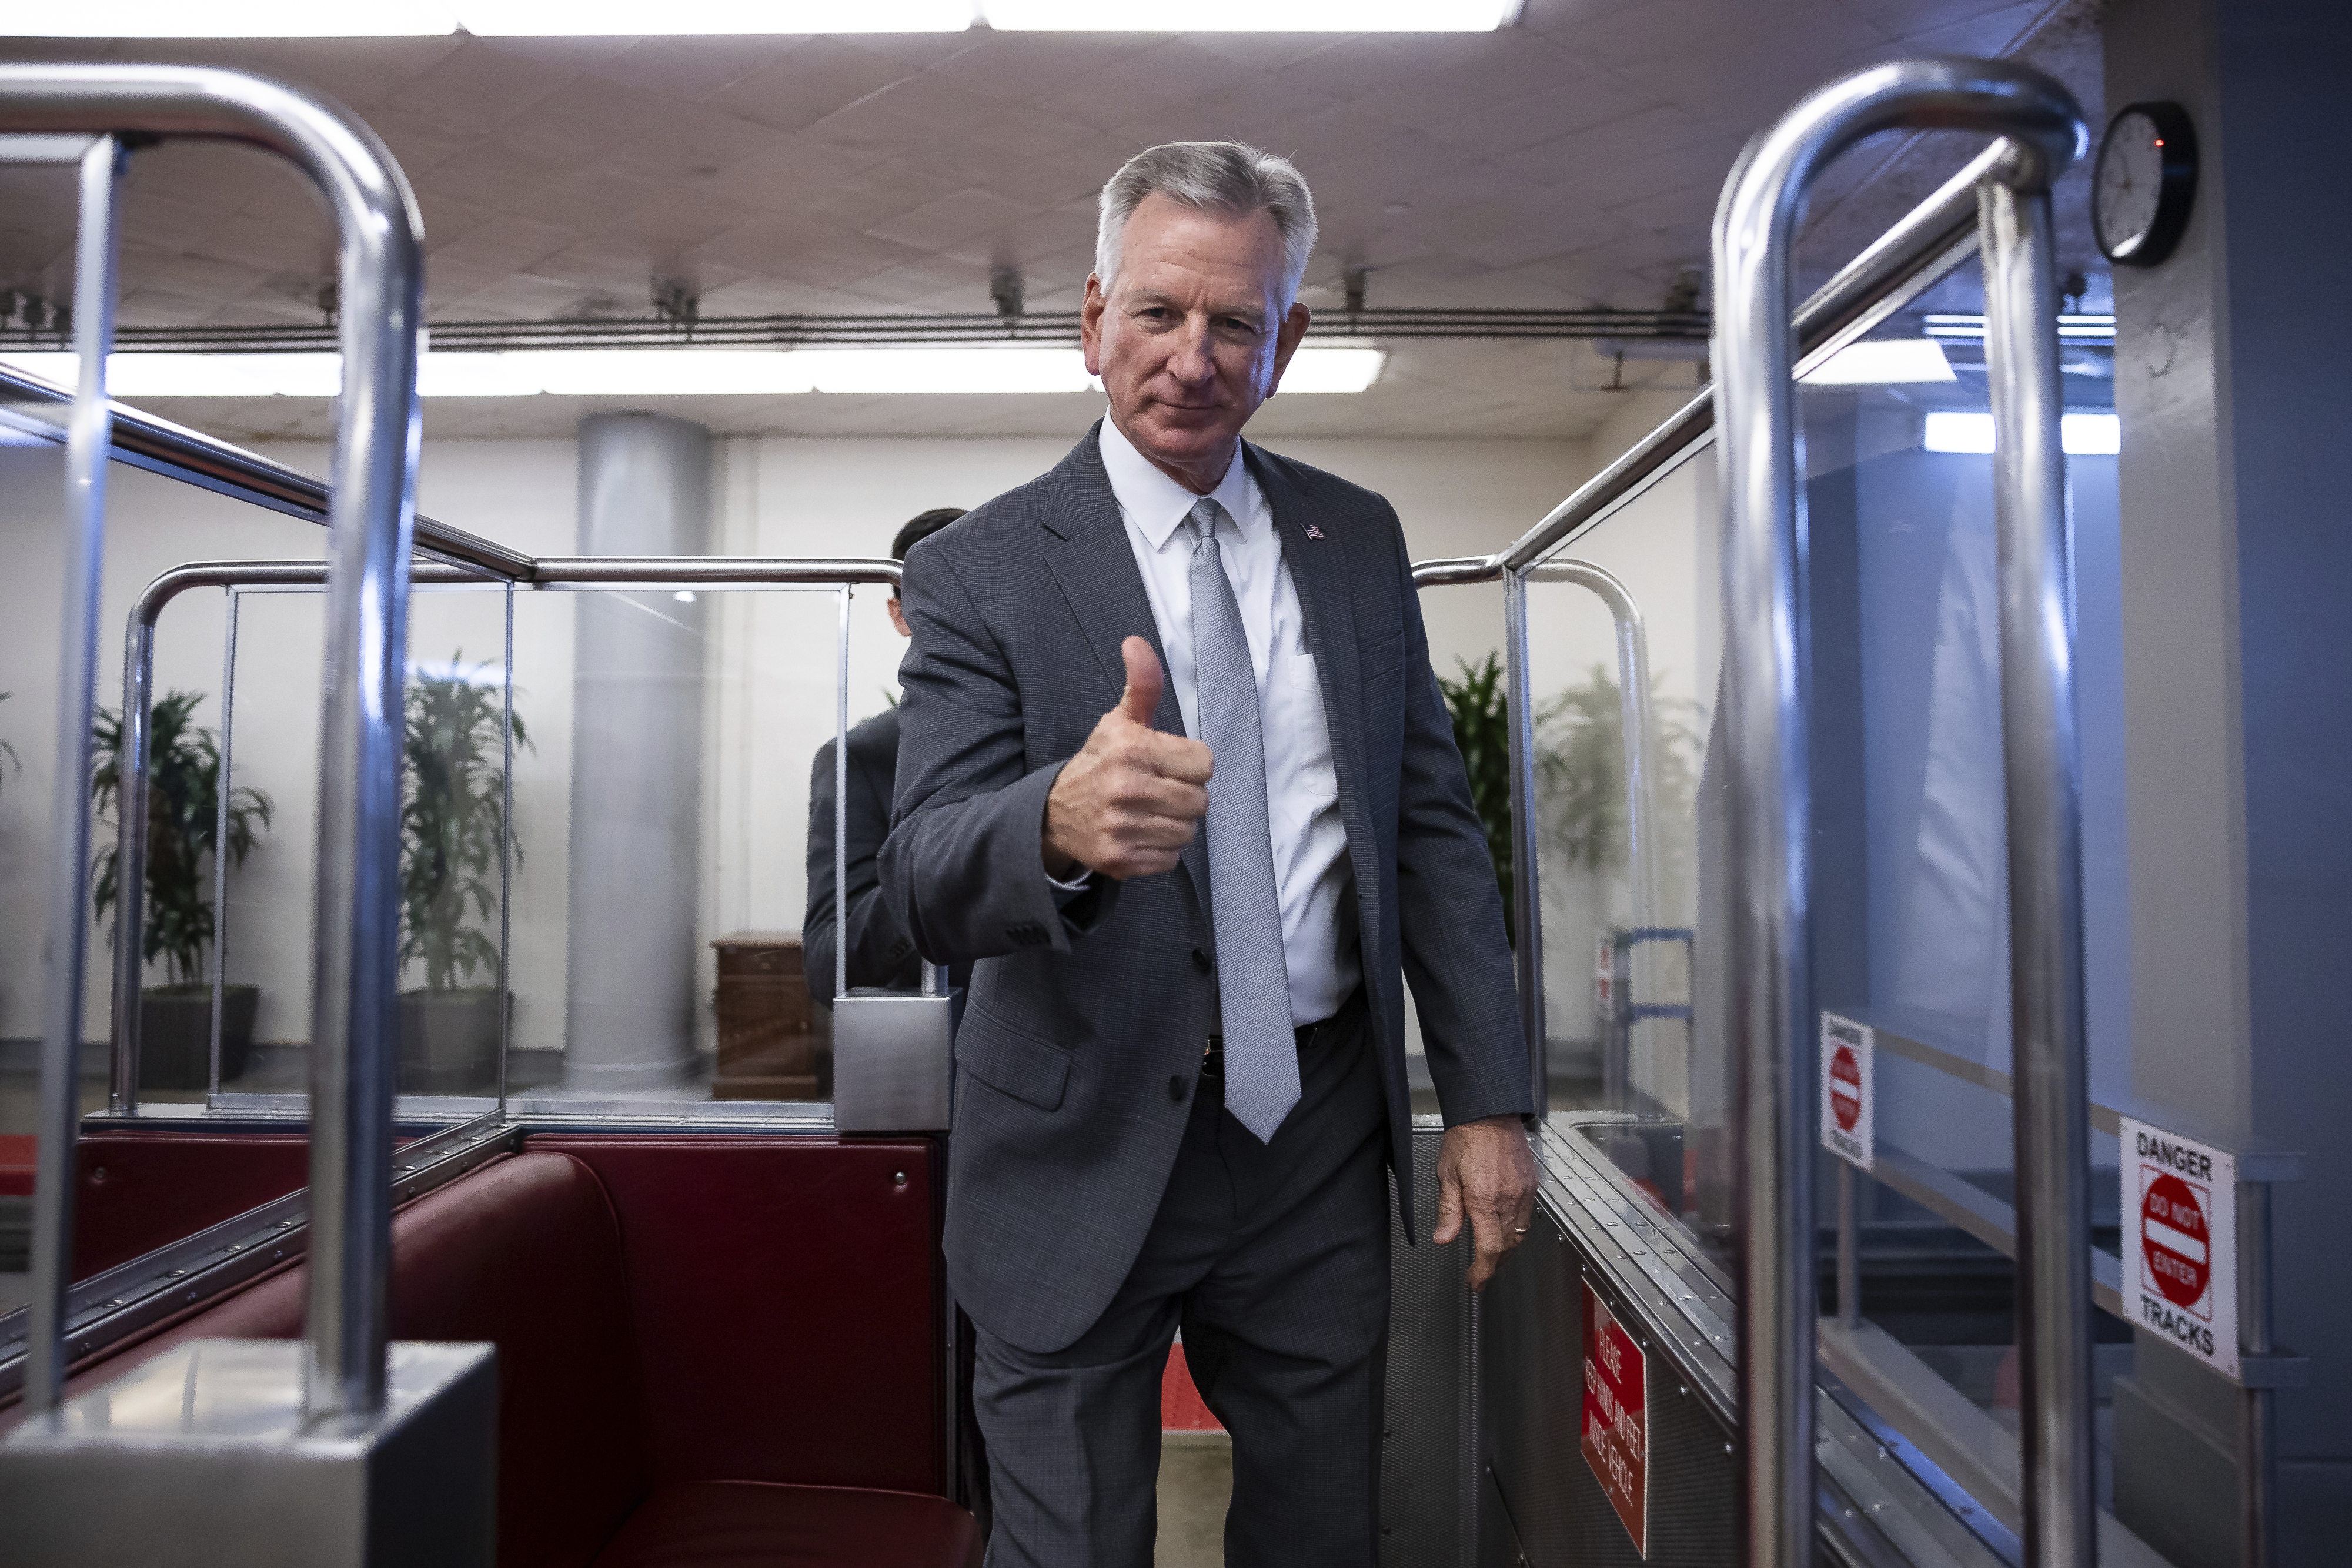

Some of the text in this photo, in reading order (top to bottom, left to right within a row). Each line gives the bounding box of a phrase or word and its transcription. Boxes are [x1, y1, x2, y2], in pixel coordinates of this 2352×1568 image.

[2137, 1131, 2213, 1183] DANGER
[2149, 1192, 2200, 1231] DO NOT
[2153, 1250, 2198, 1288] ENTER
[2140, 1294, 2215, 1356] TRACKS
[1599, 1326, 1622, 1385] PLEASE
[1589, 1410, 1634, 1507] INSIDE VEHICLE
